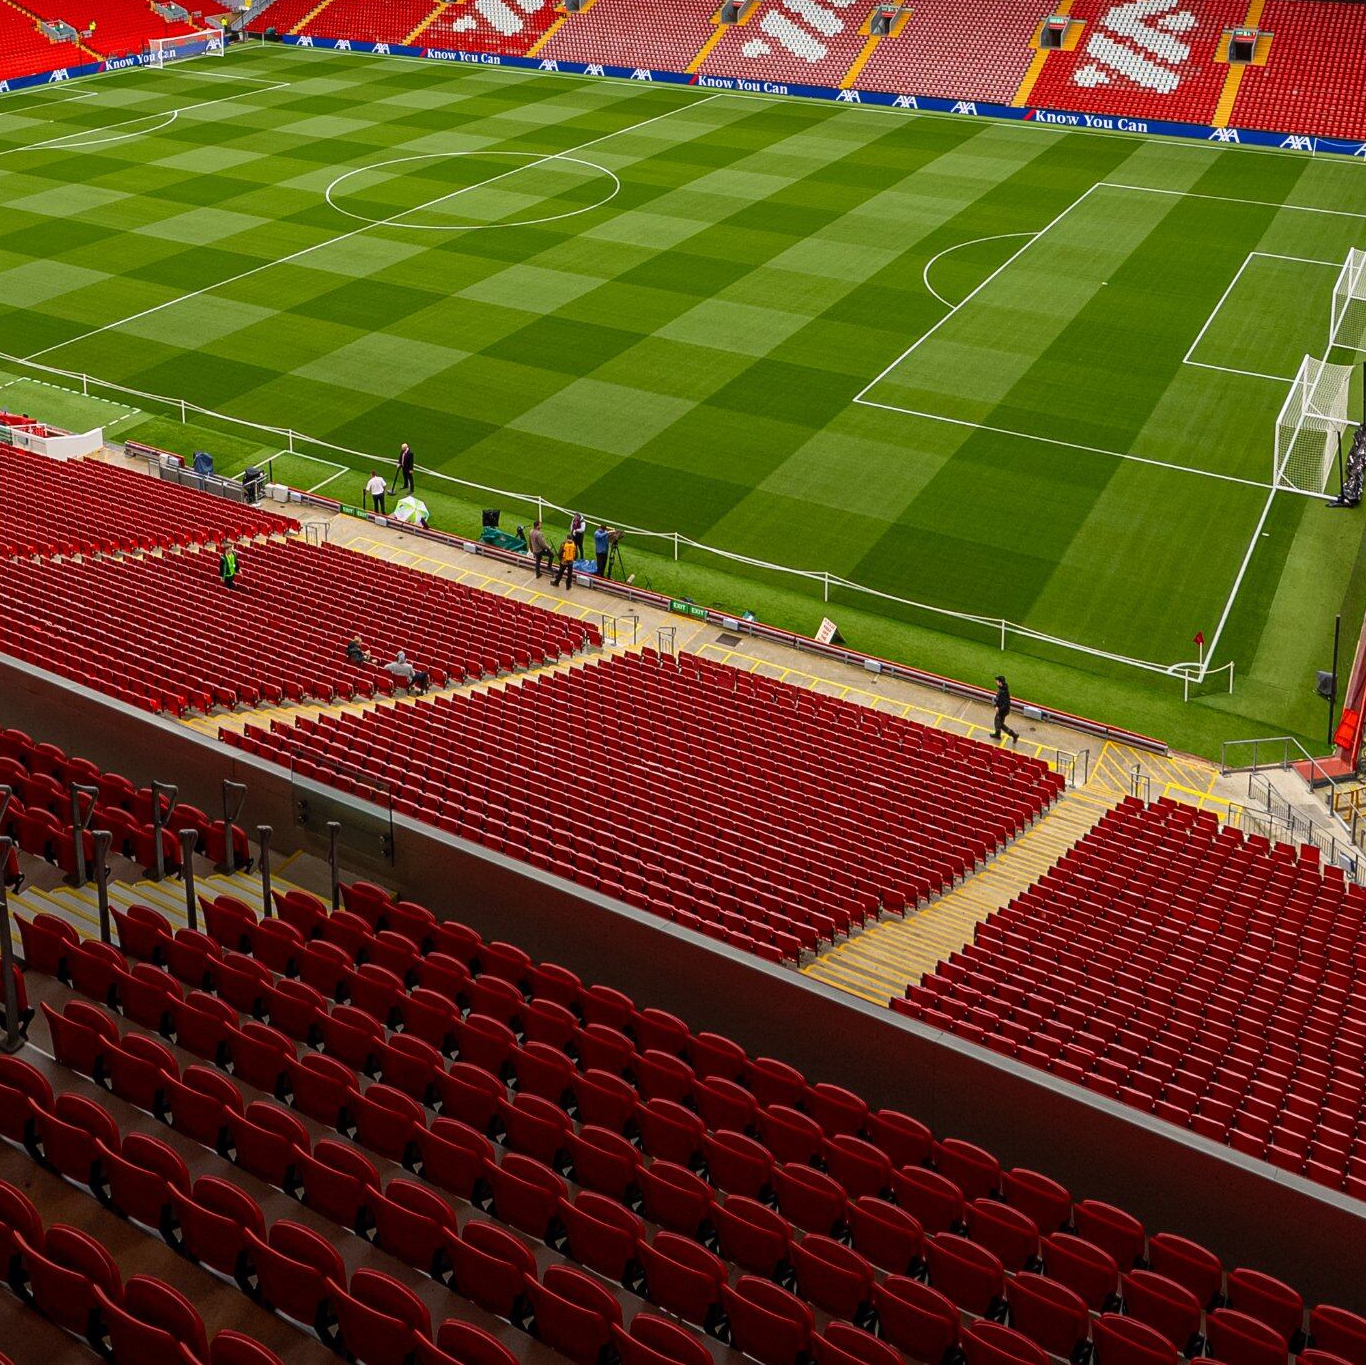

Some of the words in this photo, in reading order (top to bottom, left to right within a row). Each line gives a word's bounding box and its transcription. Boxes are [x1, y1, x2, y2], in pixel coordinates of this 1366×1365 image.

[296, 35, 313, 47] AXA
[334, 39, 352, 51] AXA
[372, 42, 390, 54] AXA
[105, 56, 135, 71] Know
[137, 52, 155, 66] You
[157, 48, 176, 61] Can
[427, 49, 458, 61] Know
[460, 51, 479, 63] You
[481, 52, 501, 65] Can
[539, 59, 559, 72] AXA
[584, 63, 605, 76] AXA
[49, 69, 70, 83] AXA
[630, 68, 653, 81] AXA
[698, 75, 734, 90] Know
[737, 79, 761, 92] You
[764, 81, 788, 95] Can
[836, 89, 861, 103] AXA
[892, 95, 918, 109] AXA
[951, 101, 978, 116] AXA
[1035, 110, 1080, 125] Know
[1083, 114, 1113, 129] You
[1117, 118, 1148, 133] Can
[1208, 127, 1240, 144] AXA
[1280, 134, 1313, 151] AXA
[673, 601, 686, 611] EXIT
[691, 607, 705, 616] EXIT
